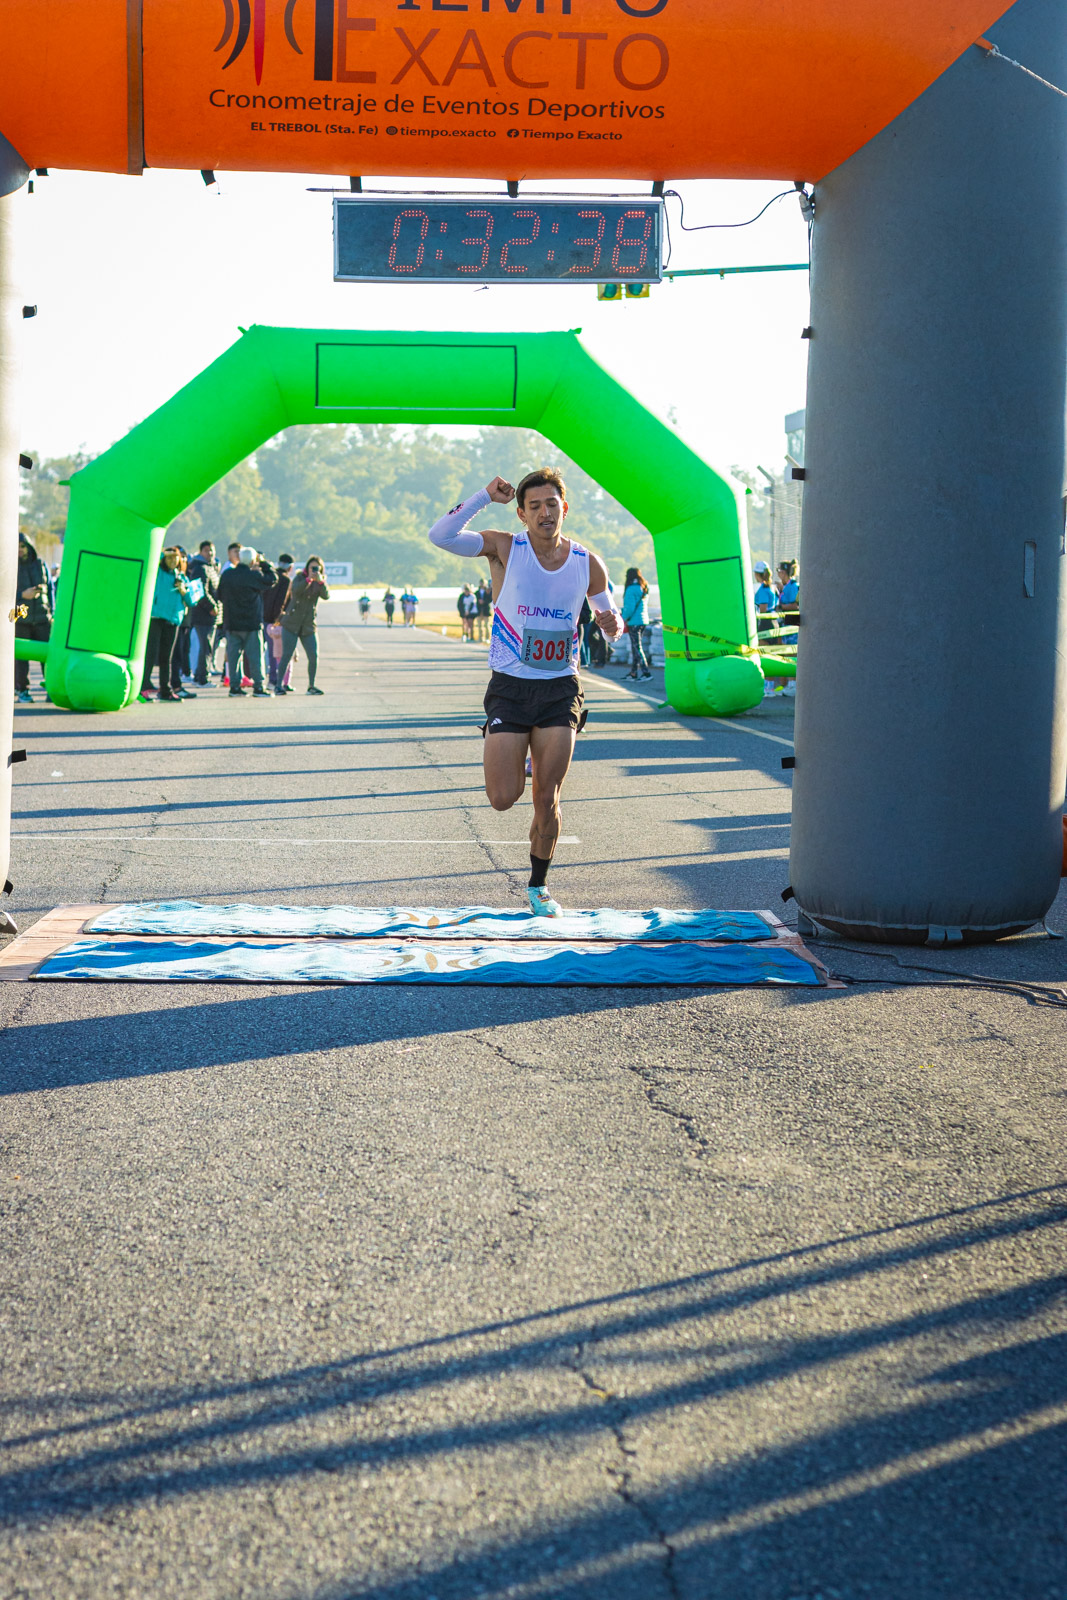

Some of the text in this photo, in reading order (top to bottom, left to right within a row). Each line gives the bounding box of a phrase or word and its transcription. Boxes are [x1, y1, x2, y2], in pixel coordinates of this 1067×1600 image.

[209, 88, 665, 121] Cronometraje de Eventos Deportivos
[250, 121, 379, 136] EL TREBOL (Sta. Fe)
[521, 129, 623, 141] Tiempo Exacto
[388, 209, 653, 274] 0:32:38
[533, 639, 565, 661] 303
